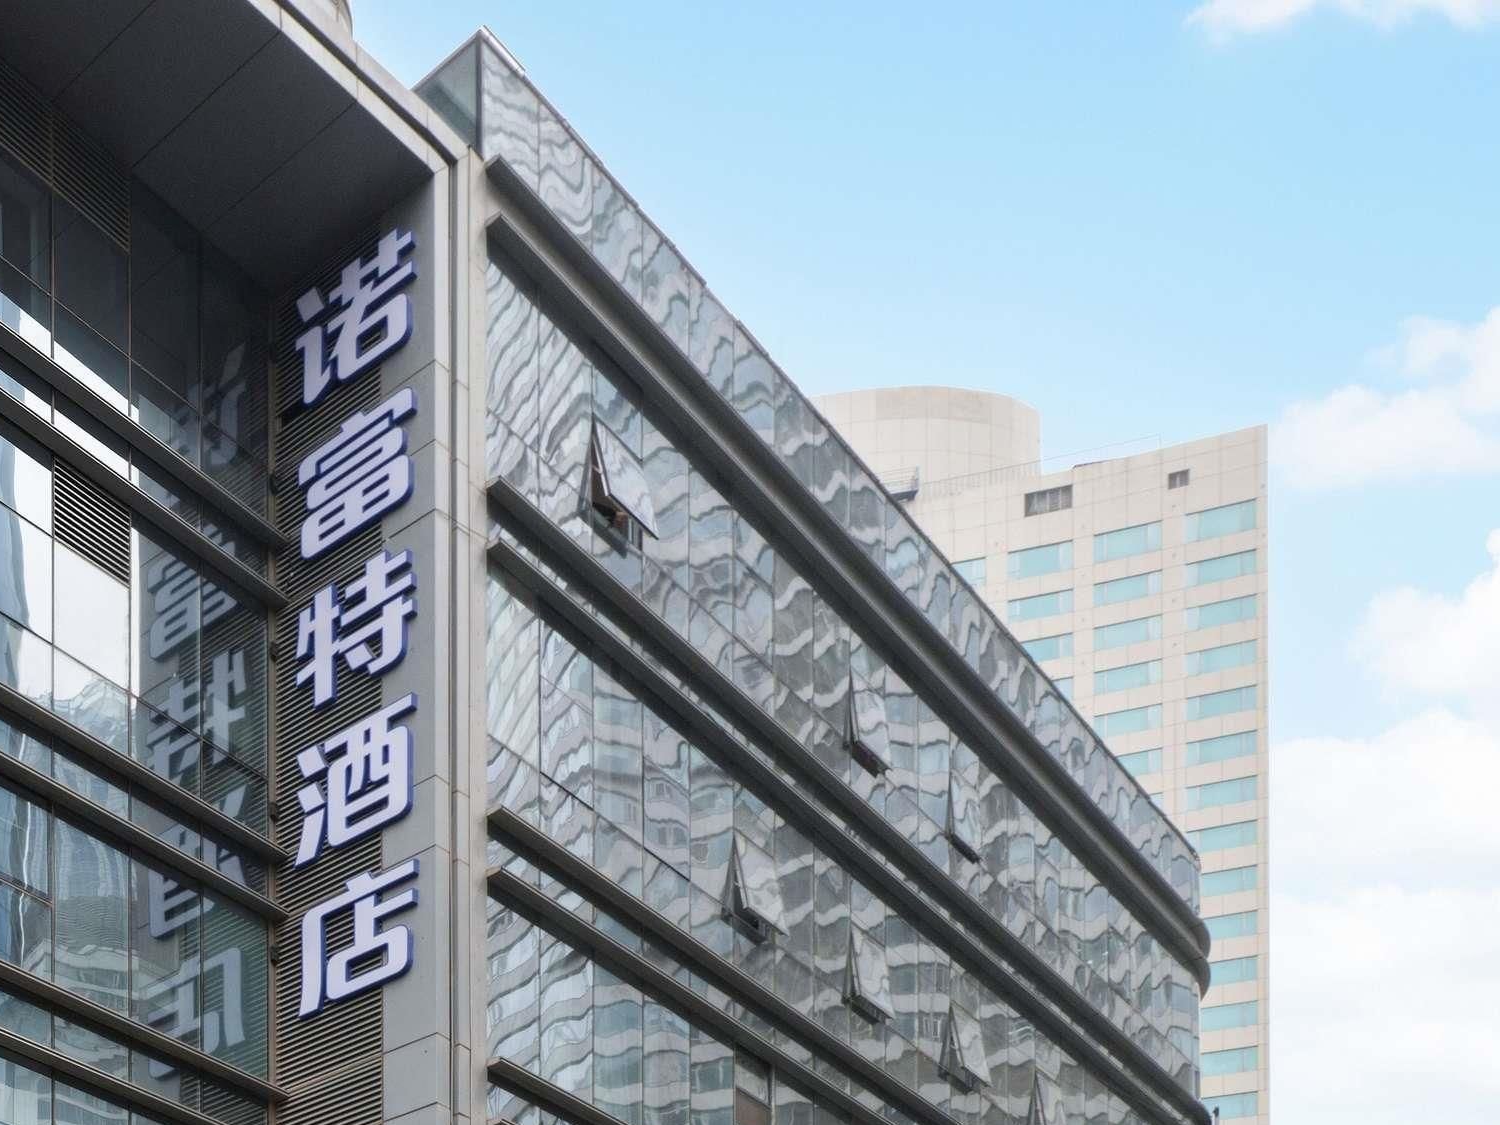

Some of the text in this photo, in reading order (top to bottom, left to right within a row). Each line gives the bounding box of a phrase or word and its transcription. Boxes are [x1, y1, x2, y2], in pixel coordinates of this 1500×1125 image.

[294, 228, 417, 1020] 诺富特酒店
